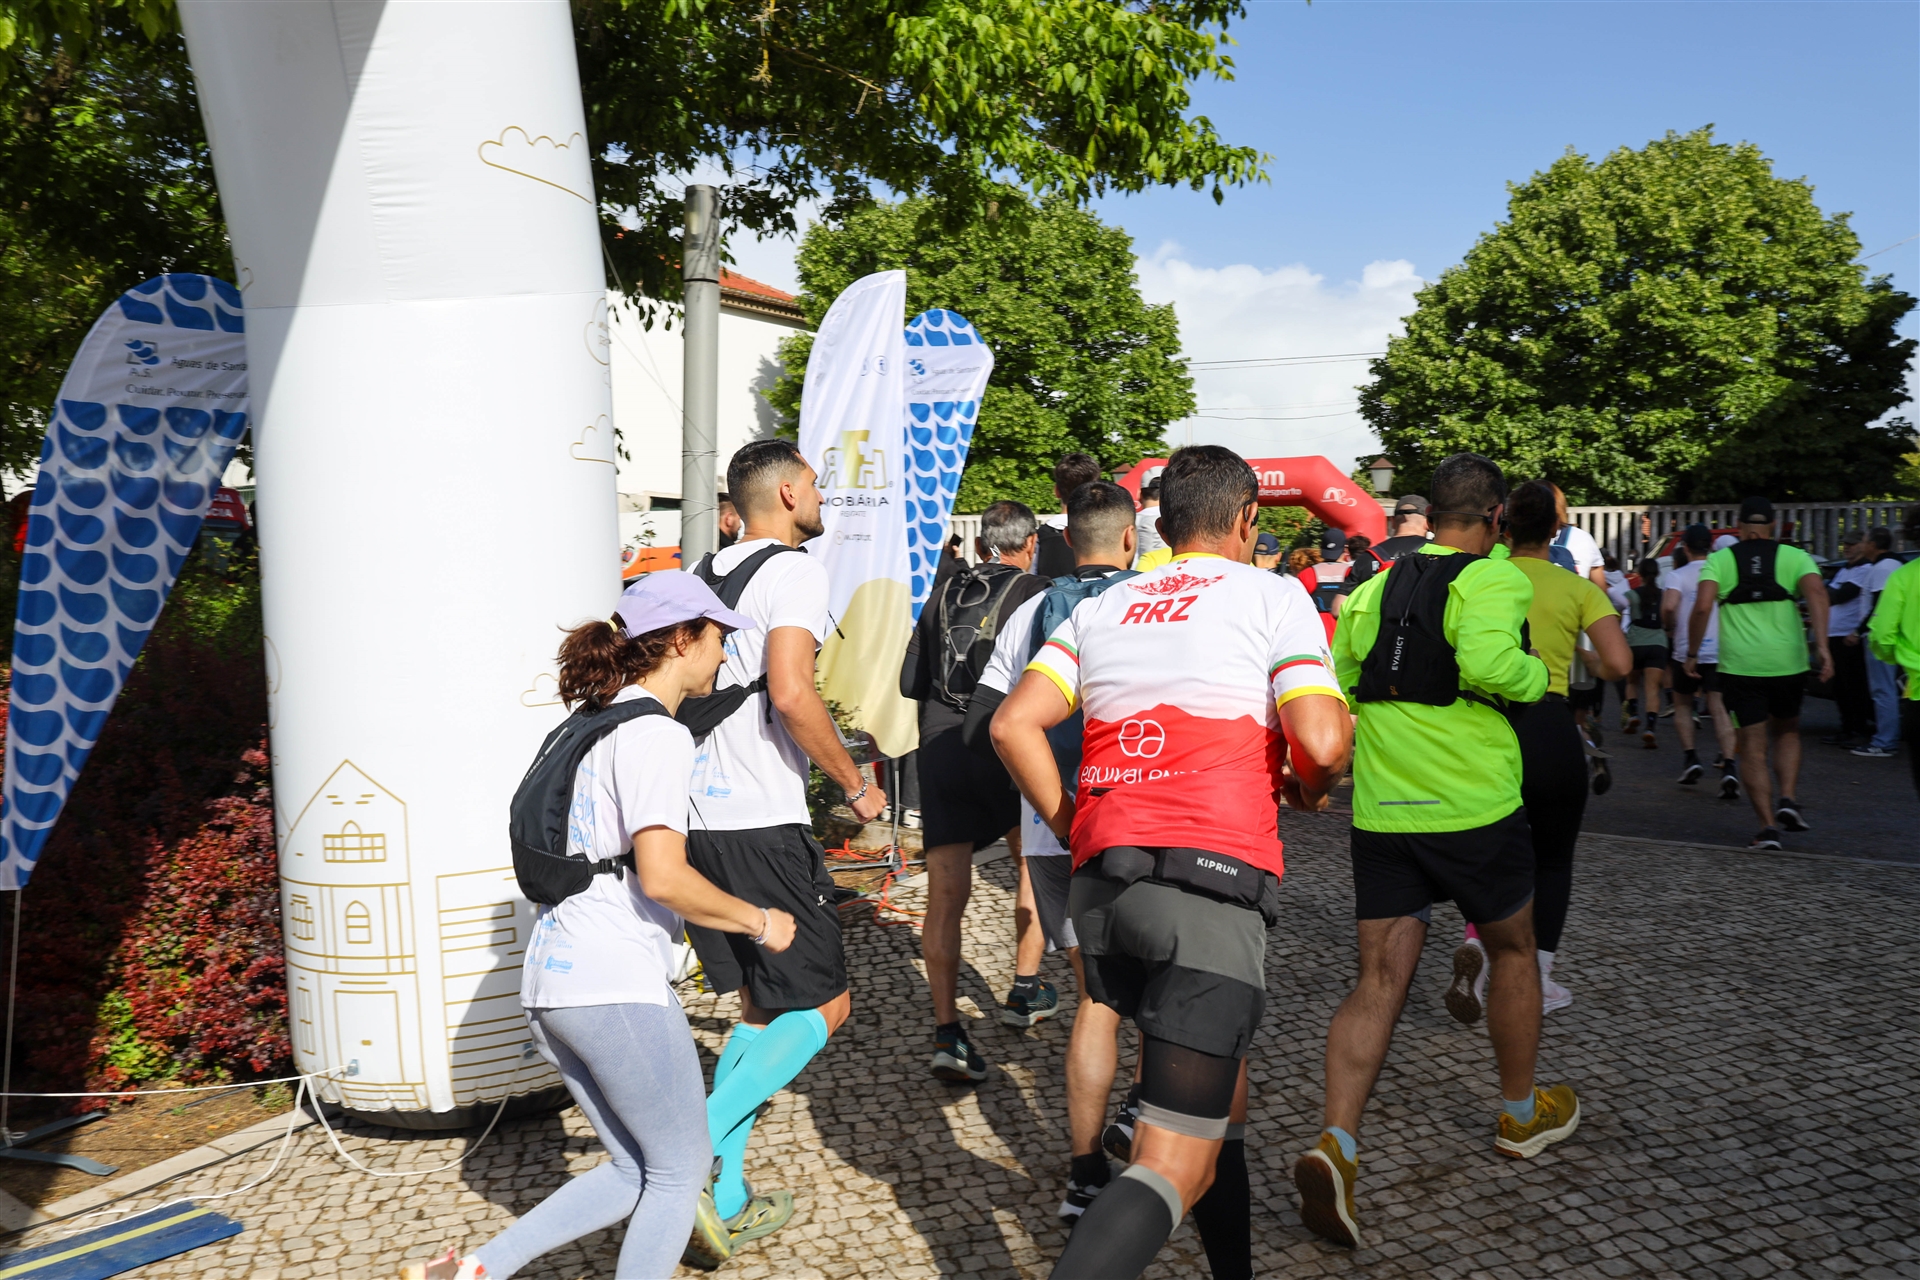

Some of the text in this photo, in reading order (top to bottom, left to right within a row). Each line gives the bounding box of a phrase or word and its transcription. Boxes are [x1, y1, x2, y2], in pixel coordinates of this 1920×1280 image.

[205, 361, 219, 371] de
[1119, 594, 1199, 625] ARZ
[1391, 635, 1404, 671] EVADICT
[569, 825, 592, 849] TRAIL
[1196, 856, 1239, 877] KIPRUN
